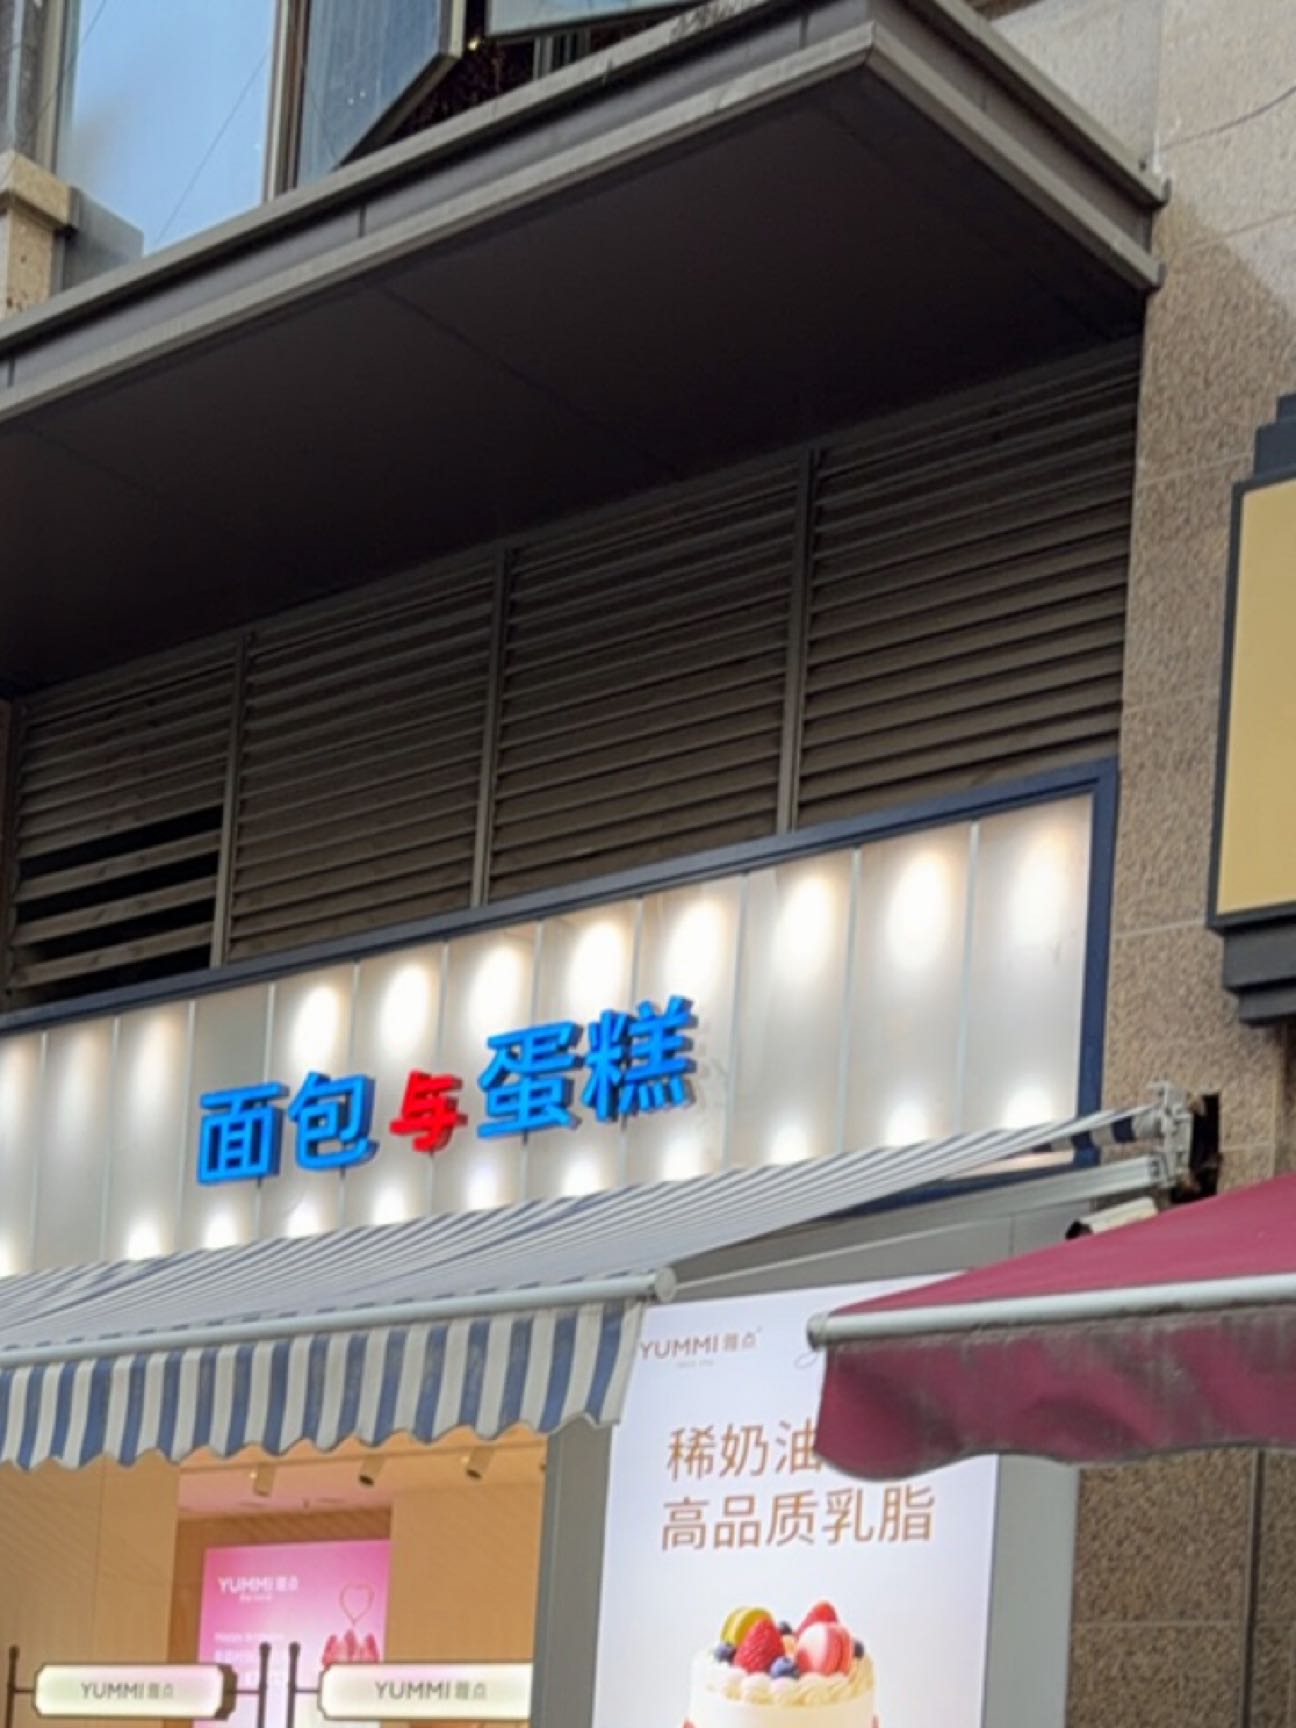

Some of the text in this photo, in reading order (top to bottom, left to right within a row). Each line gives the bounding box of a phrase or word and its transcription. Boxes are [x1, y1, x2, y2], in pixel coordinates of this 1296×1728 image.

[197, 996, 696, 1185] 面包与蛋糕
[641, 1333, 719, 1360] YUMMI
[667, 1417, 823, 1482] 稀奶油
[662, 1484, 936, 1551] 高品质乳脂
[81, 1682, 145, 1700] YUMMI
[375, 1681, 451, 1700] YUMMI
